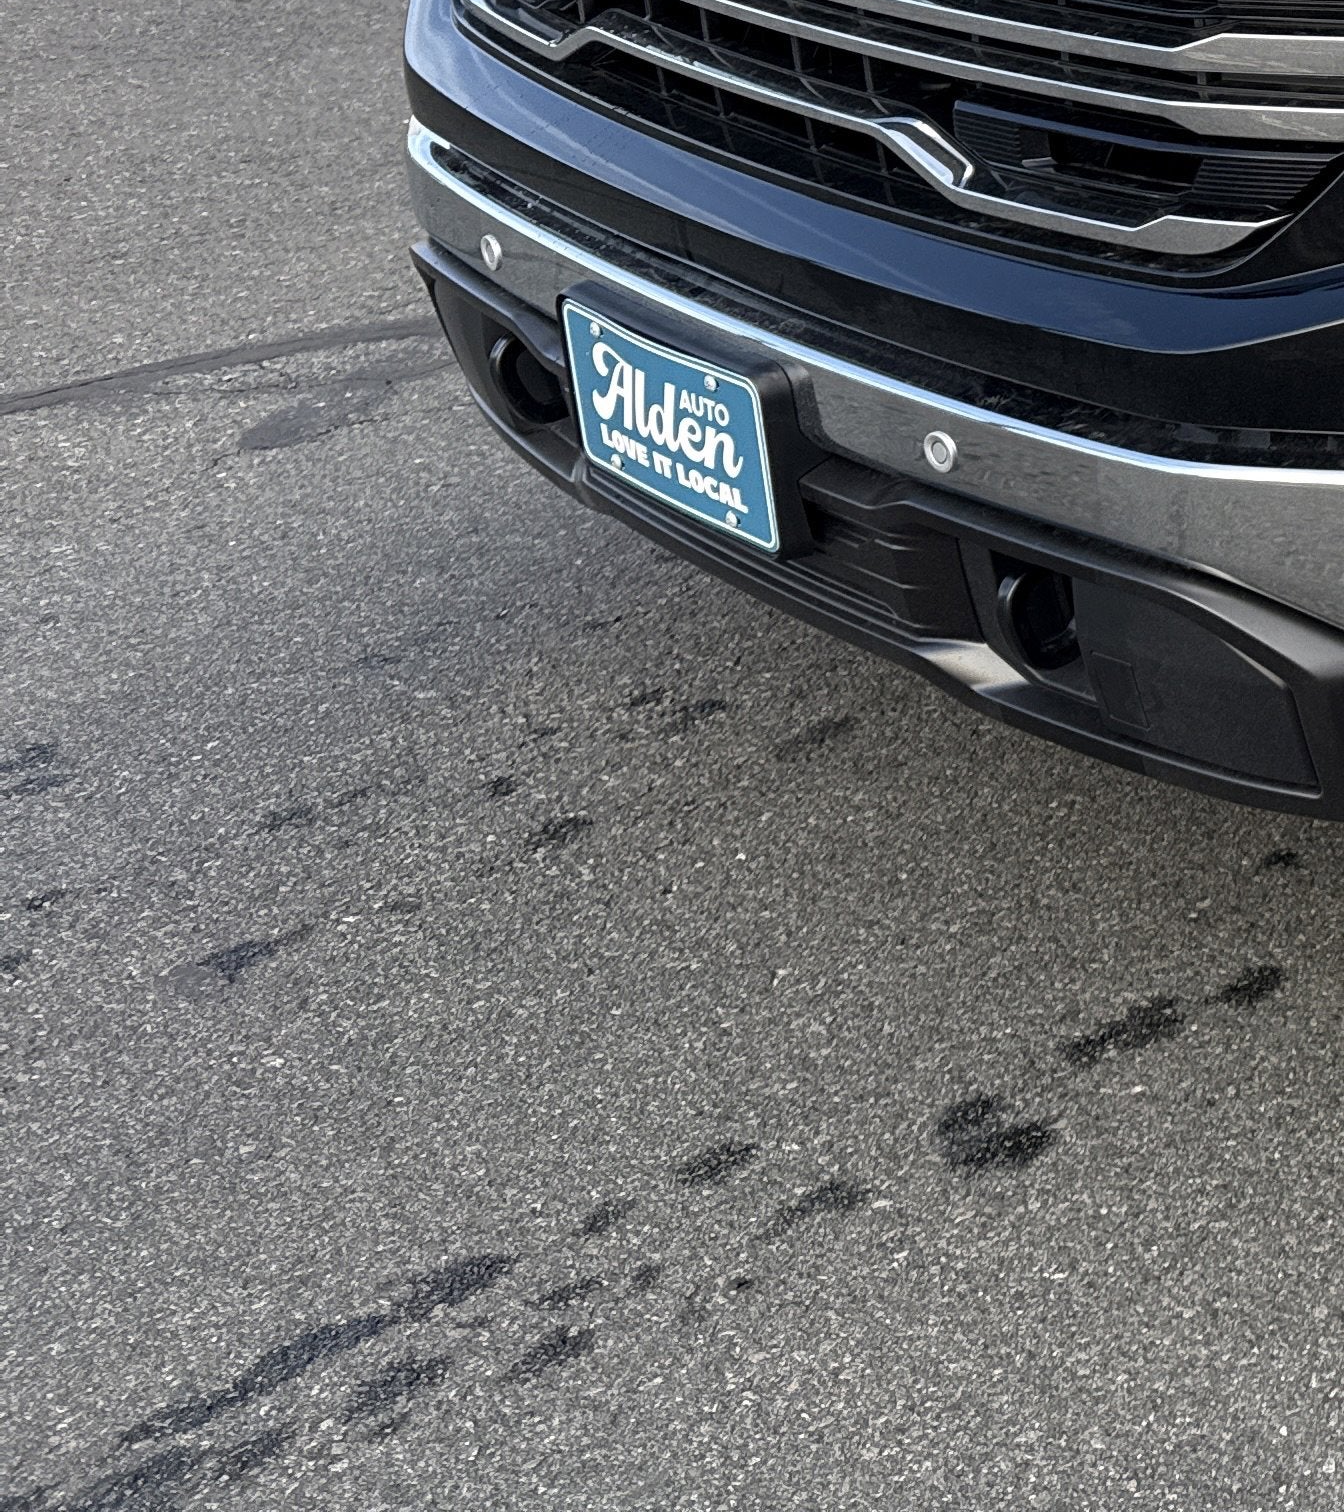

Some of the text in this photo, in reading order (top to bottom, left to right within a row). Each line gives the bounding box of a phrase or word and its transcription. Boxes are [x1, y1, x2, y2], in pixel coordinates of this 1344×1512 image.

[592, 341, 744, 479] Alden
[679, 389, 730, 427] AUTO
[600, 422, 749, 514] LOVE IT LOCAL
